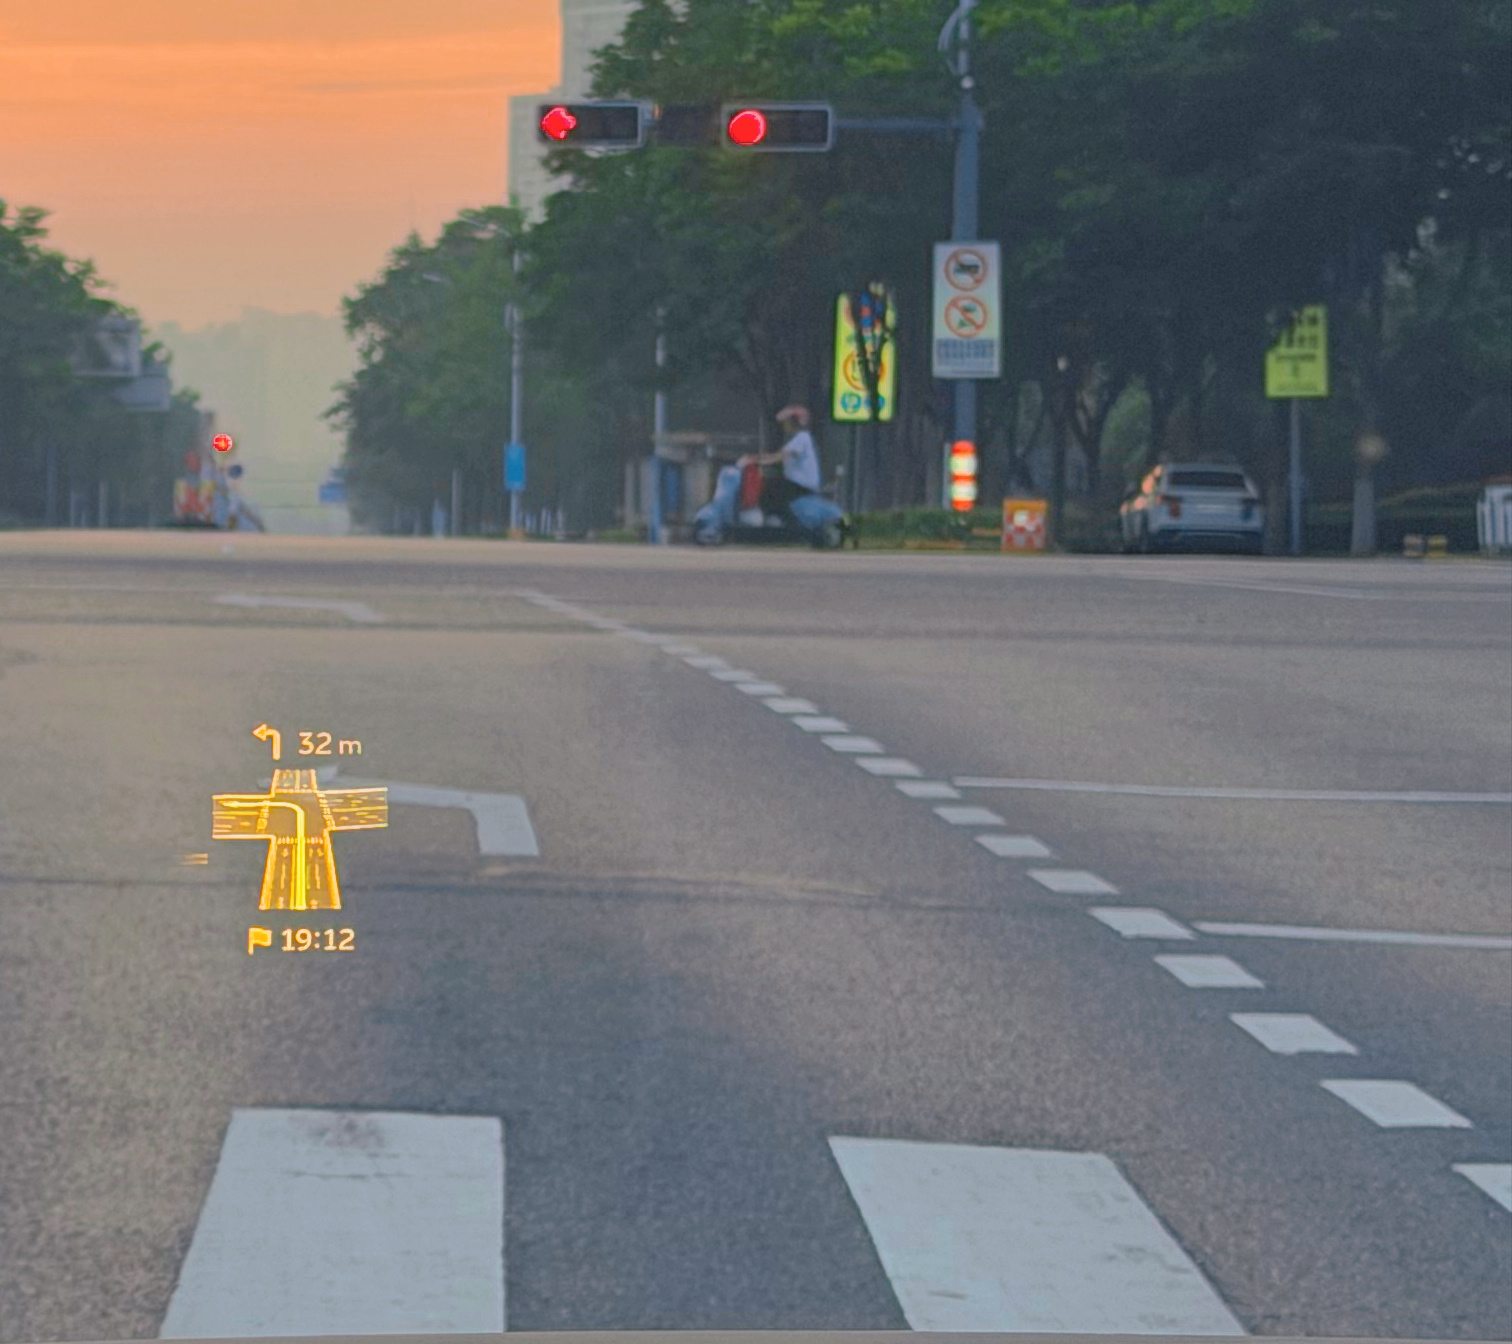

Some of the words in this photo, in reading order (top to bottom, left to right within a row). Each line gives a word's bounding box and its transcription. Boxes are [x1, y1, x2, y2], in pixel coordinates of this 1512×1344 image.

[298, 731, 332, 755] 32
[339, 738, 362, 755] m
[281, 928, 355, 951] 19:12
